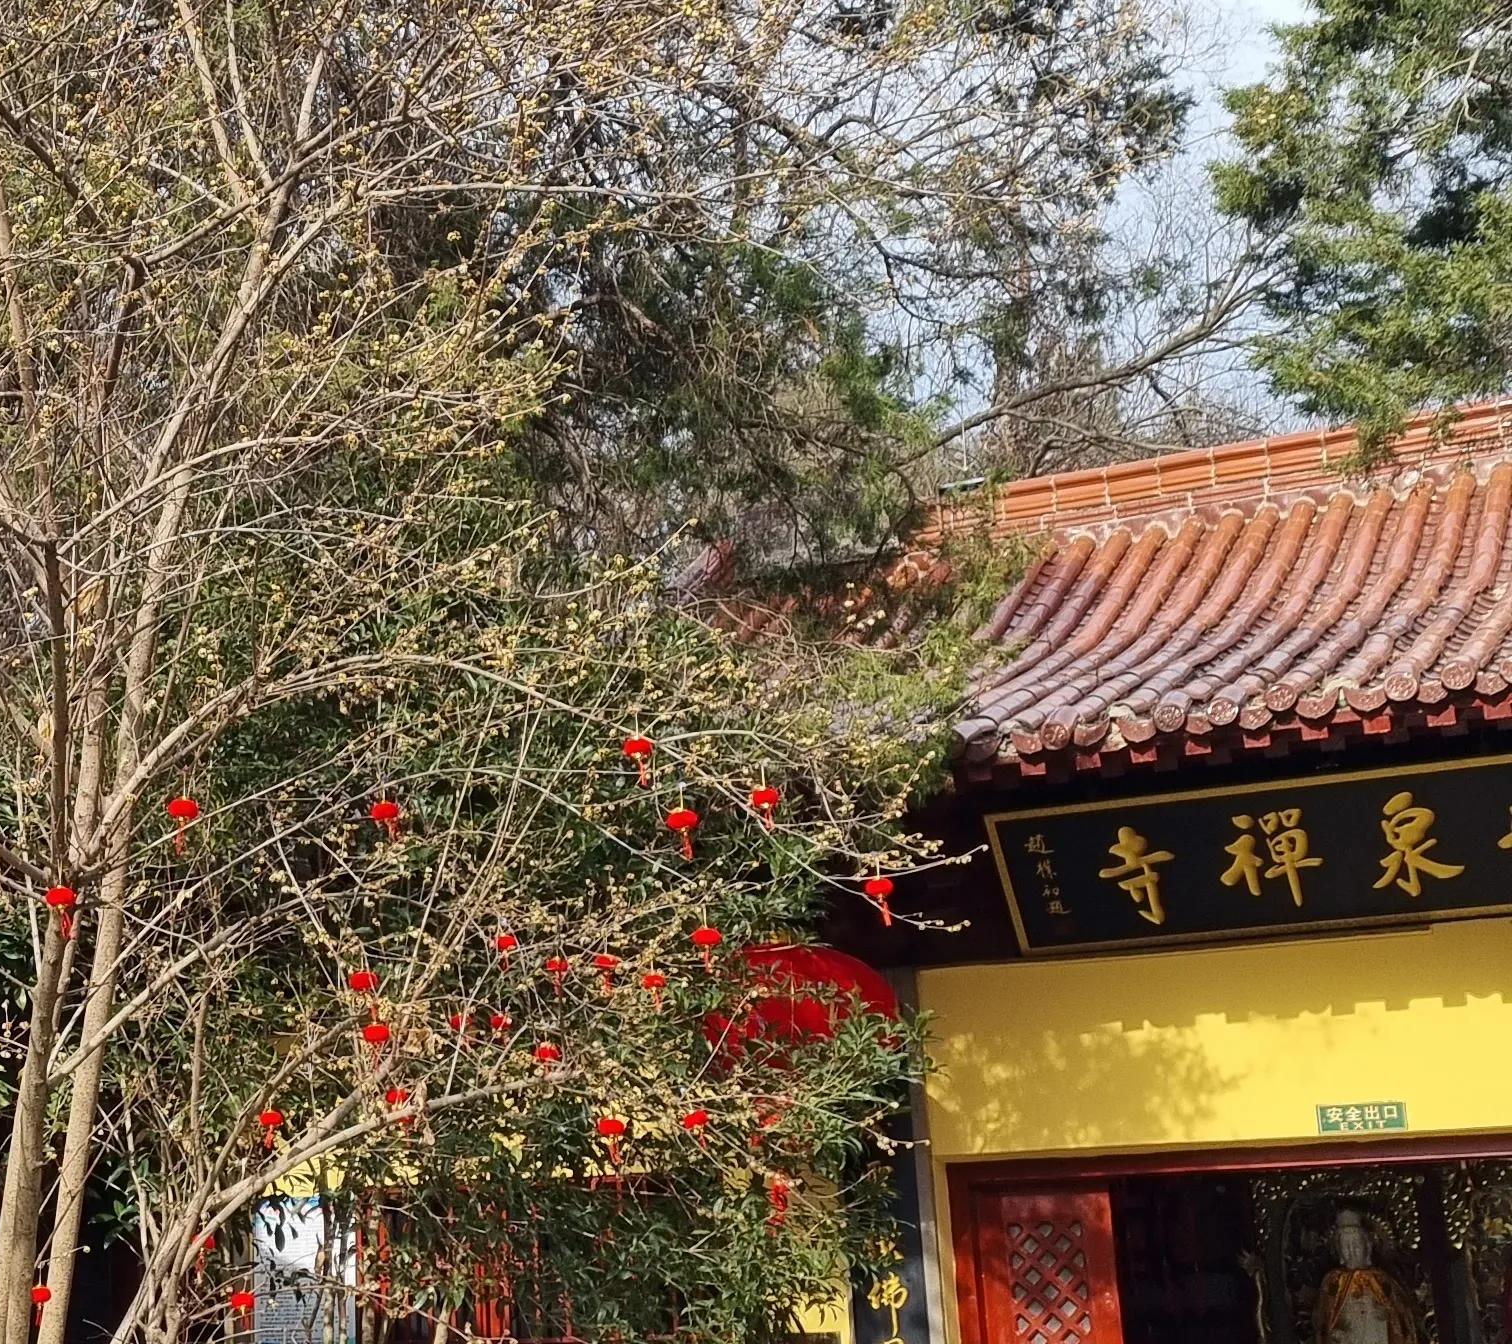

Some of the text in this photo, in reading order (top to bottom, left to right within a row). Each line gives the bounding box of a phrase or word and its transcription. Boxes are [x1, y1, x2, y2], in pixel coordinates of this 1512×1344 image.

[1098, 790, 1512, 925] 泉禪寺
[1326, 1104, 1398, 1122] 安全出口
[1339, 1119, 1387, 1131] EXIT
